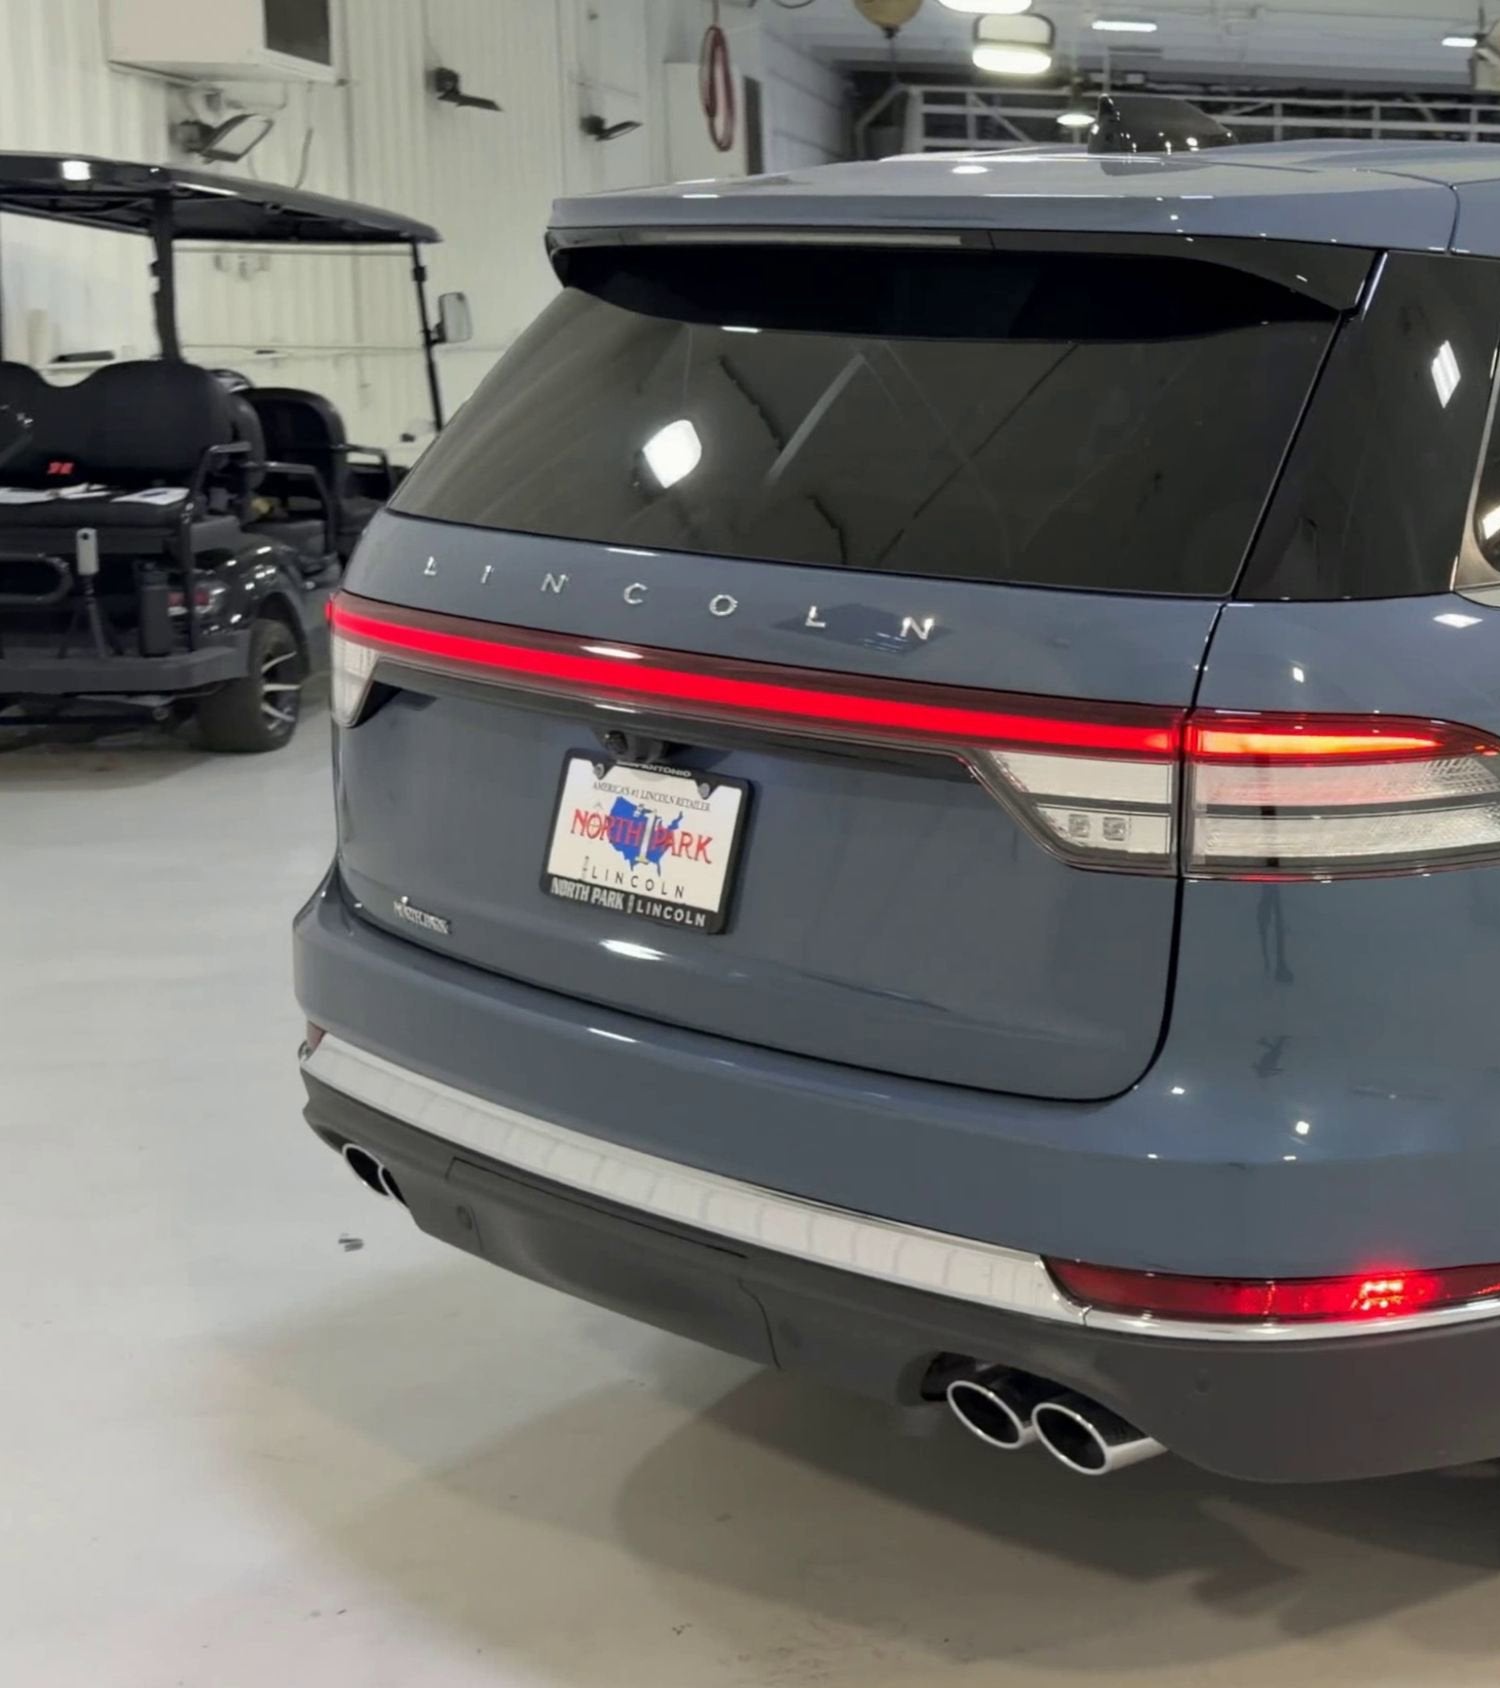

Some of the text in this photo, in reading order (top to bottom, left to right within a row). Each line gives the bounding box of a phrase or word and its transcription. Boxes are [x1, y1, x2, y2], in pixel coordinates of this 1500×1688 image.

[423, 556, 936, 641] LINCOLN
[640, 789, 674, 804] LINCOLN
[675, 797, 711, 812] RETAILER
[571, 808, 713, 864] NORTH PARK
[551, 876, 706, 927] NORTH PARK LINCOLN
[591, 866, 685, 899] LINCOLN
